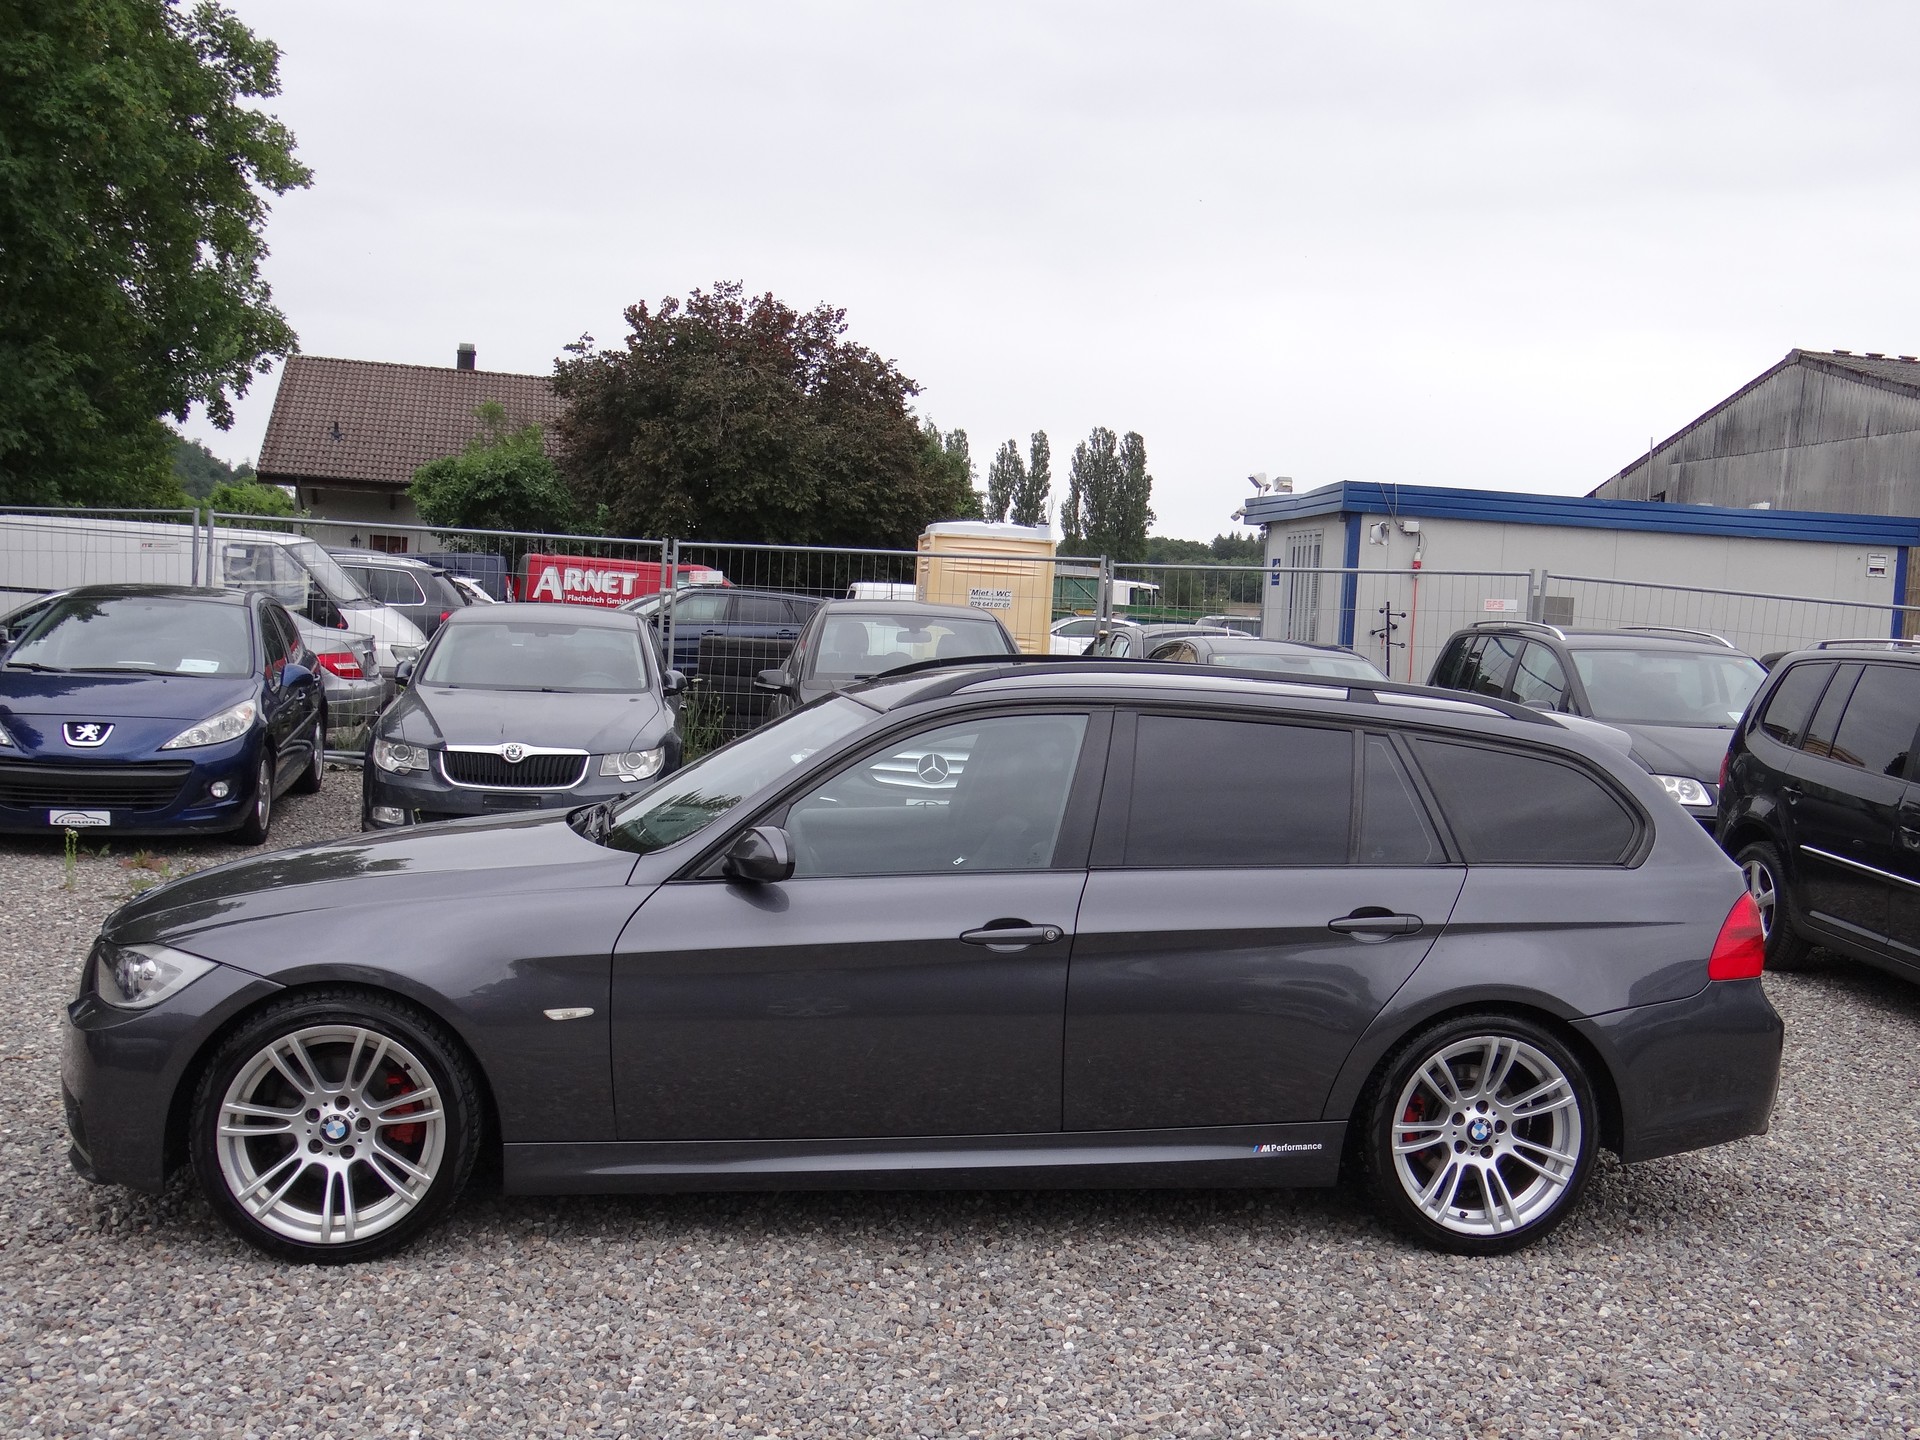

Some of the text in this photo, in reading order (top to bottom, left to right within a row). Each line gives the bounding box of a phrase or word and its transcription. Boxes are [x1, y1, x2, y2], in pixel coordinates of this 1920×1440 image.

[532, 566, 639, 599] ARNET
[567, 594, 630, 605] Flachdach GmbH
